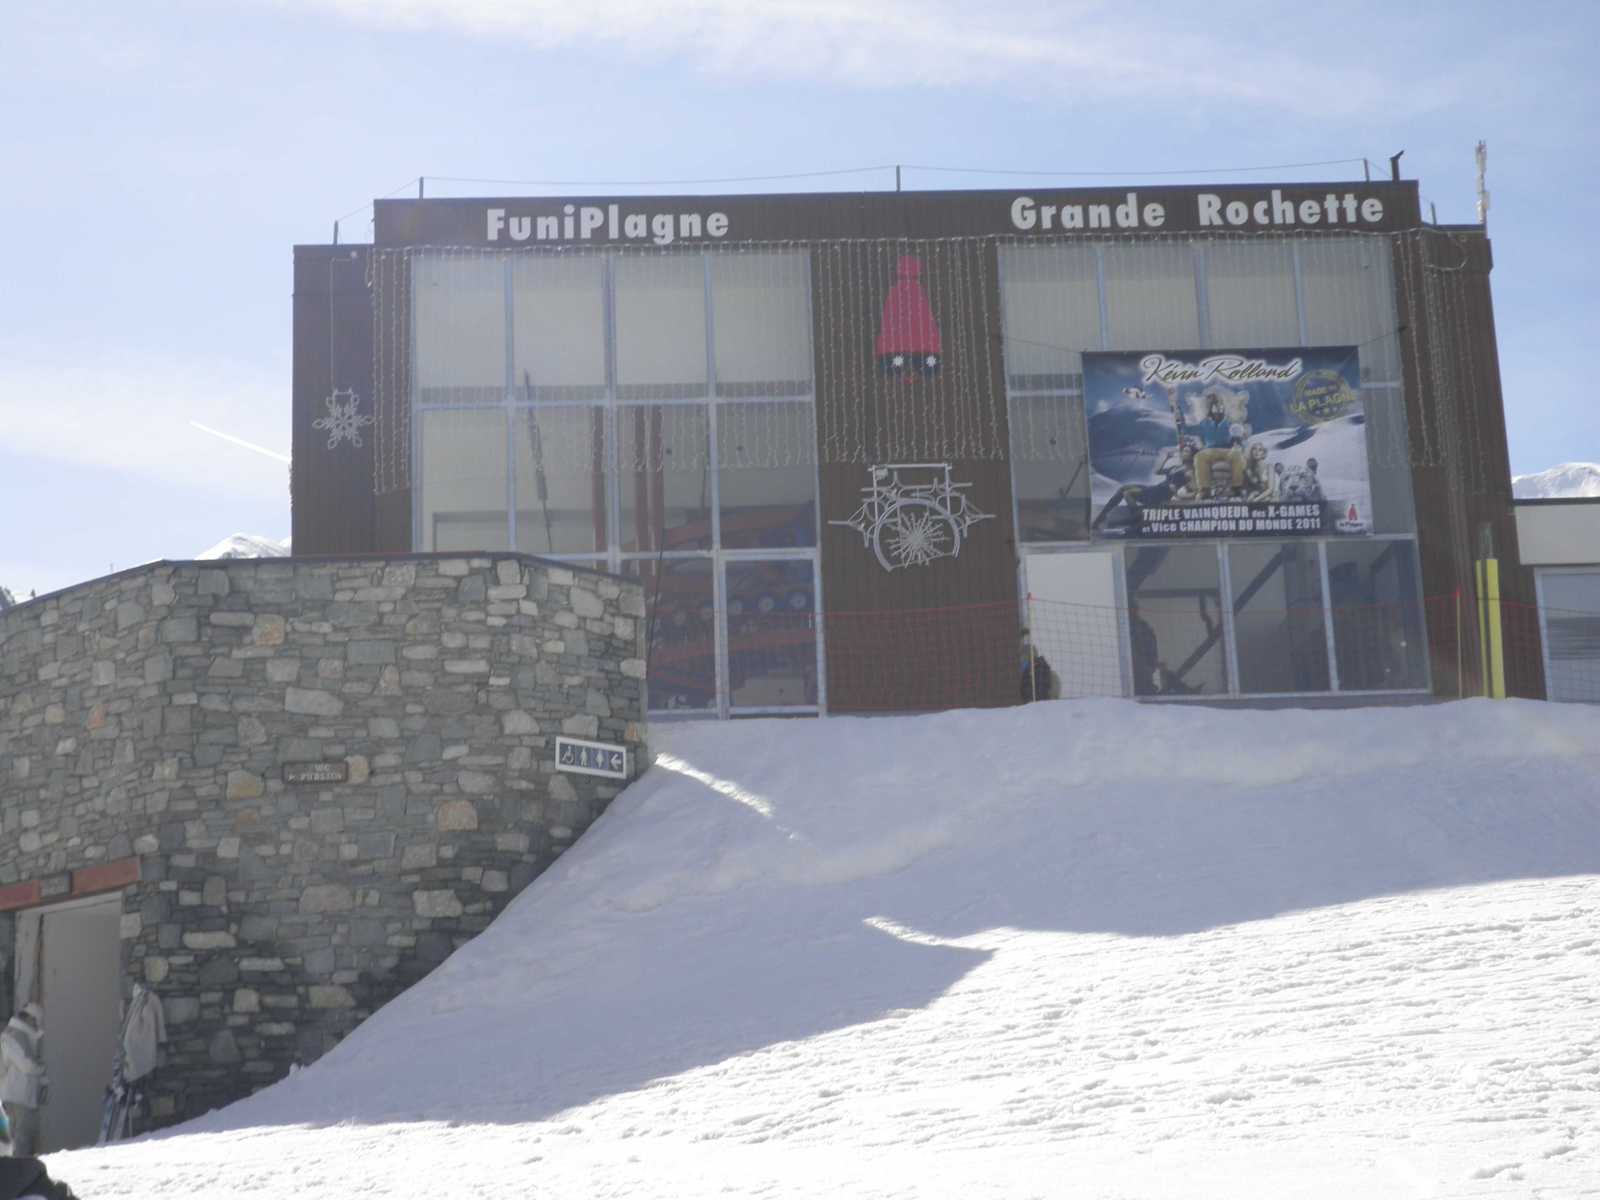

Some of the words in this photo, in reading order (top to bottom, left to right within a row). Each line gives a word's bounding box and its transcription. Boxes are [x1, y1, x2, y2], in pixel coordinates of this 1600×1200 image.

[1010, 192, 1165, 230] Grande
[1197, 189, 1384, 226] Rochette
[486, 204, 729, 245] FuniPlagne
[1200, 356, 1300, 381] Rolland
[1142, 508, 1181, 521] TRIPLE
[1183, 506, 1249, 519] VAINQUEUR
[1268, 504, 1320, 517] X-GAMES
[1151, 523, 1177, 533] Vice
[1179, 520, 1236, 532] CHAMPION
[1239, 519, 1253, 531] DU
[1256, 519, 1293, 530] MONDE
[1296, 518, 1321, 529] 2011
